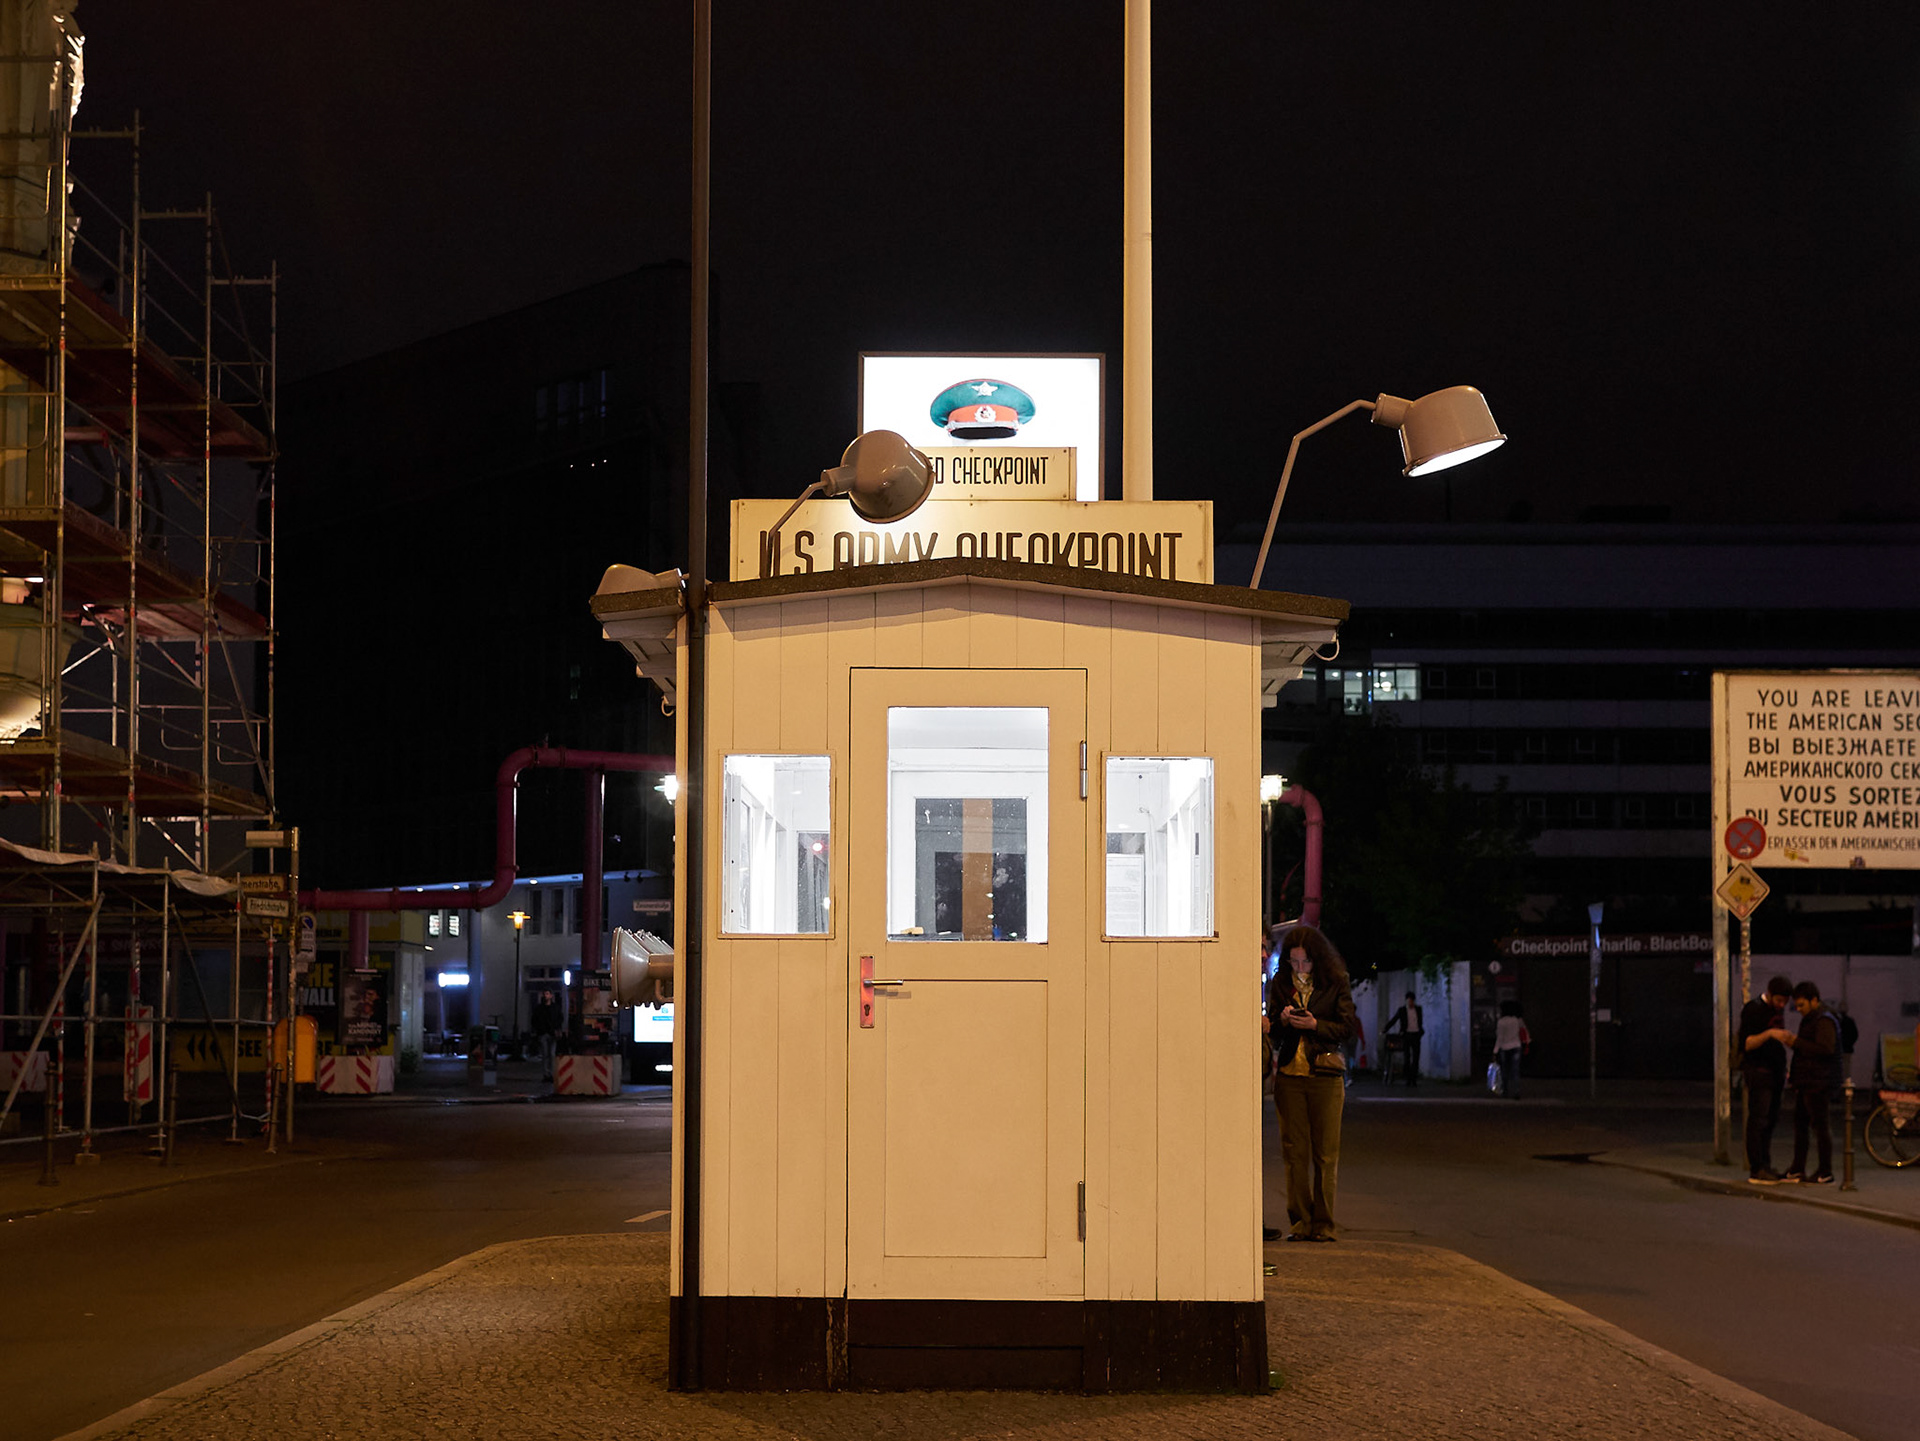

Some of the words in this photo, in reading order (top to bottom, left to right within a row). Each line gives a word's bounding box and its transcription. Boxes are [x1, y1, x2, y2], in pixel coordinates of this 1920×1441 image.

[953, 456, 1049, 485] CHECKPOINT
[833, 530, 939, 570] ARMY
[1757, 690, 1798, 708] YOU
[1811, 690, 1851, 708] ARE
[1865, 690, 1920, 708] LEAVI
[1747, 712, 1778, 730] THE
[1788, 713, 1882, 731] AMERICAN
[1749, 737, 1780, 755] ВЫ
[1793, 737, 1916, 756] ВЫЕЗЖАЕТЕ
[1744, 761, 1883, 779] АМЕРИКАНСКОГО
[1779, 785, 1836, 805] VOUS
[1777, 808, 1857, 828] SECTEUR
[1863, 808, 1919, 829] AMÉRI
[1767, 836, 1816, 850] ERLASSEN
[1818, 836, 1838, 850] DEN
[1510, 938, 1588, 956] Checkpoint
[1598, 936, 1641, 953] harlie
[308, 963, 334, 988] HE
[237, 1039, 262, 1057] SEE
